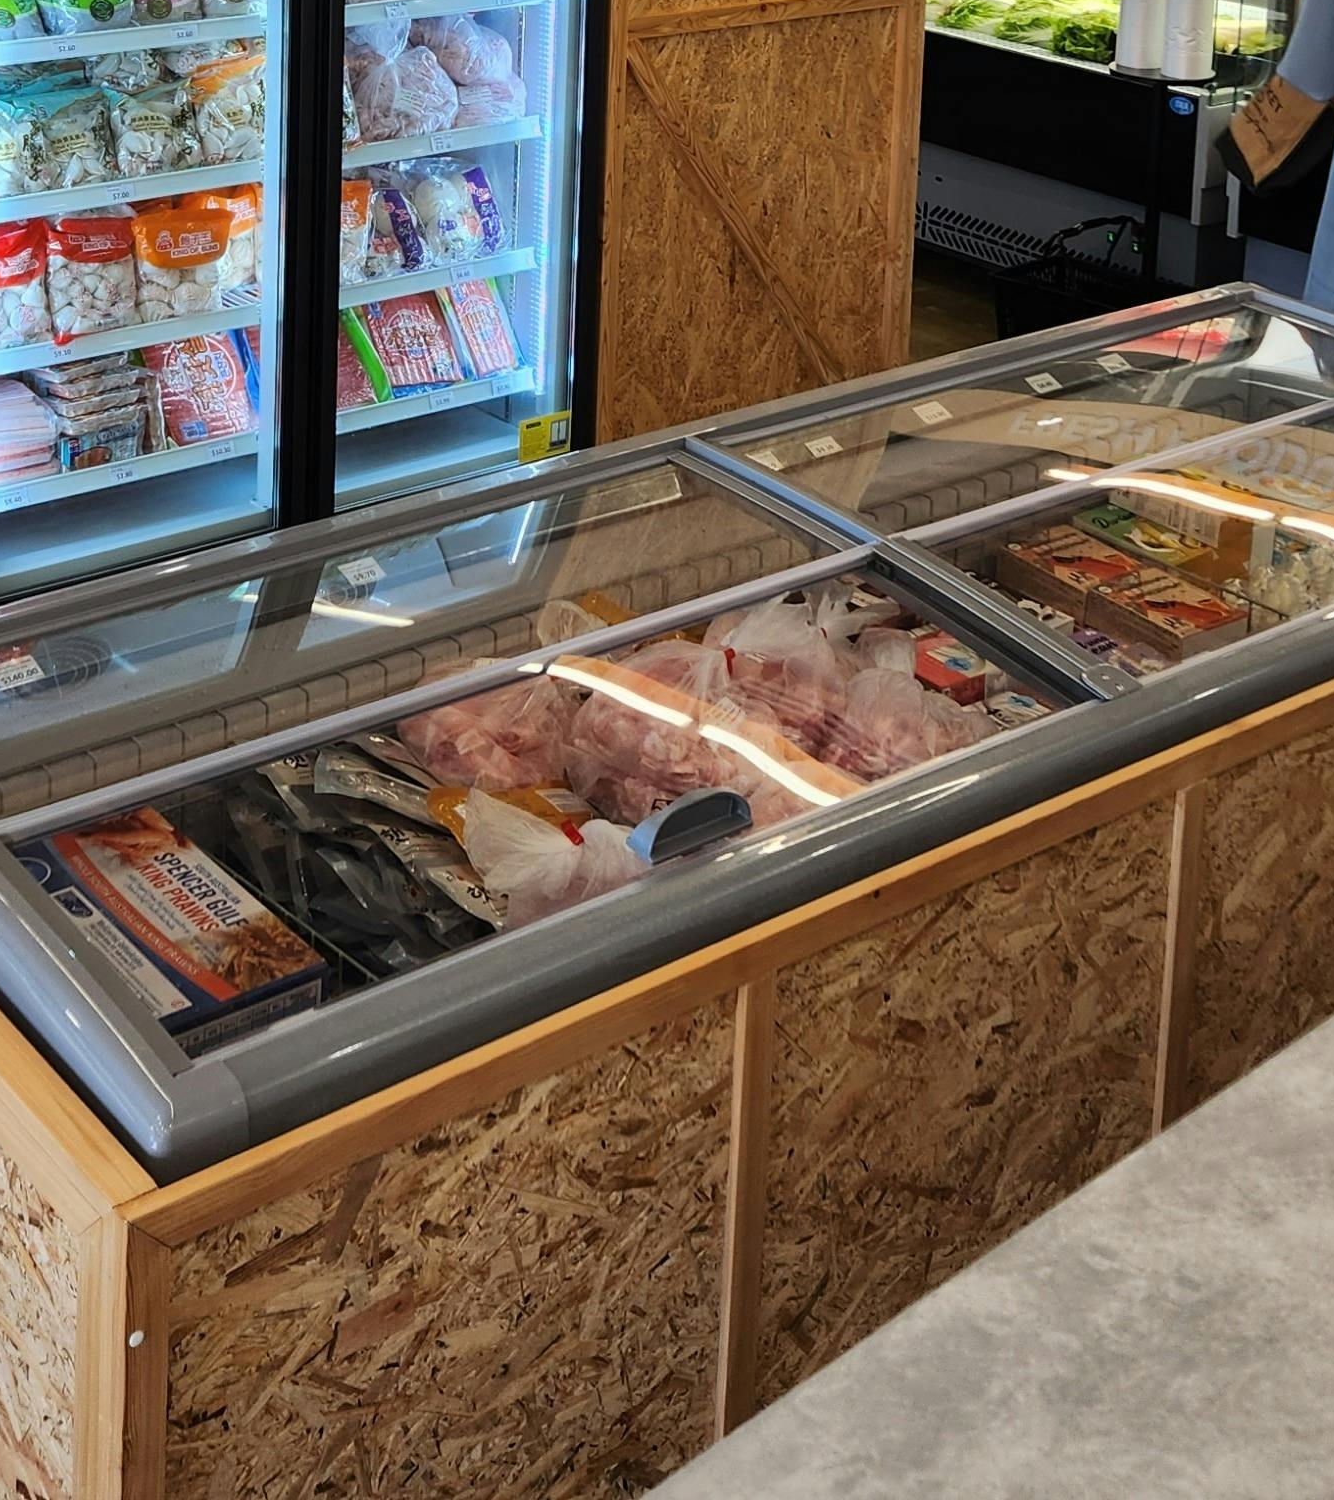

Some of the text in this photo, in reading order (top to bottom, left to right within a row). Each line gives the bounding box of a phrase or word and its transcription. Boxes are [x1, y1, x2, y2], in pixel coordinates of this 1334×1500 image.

[137, 862, 172, 891] KING
[162, 884, 221, 934] PRAWNS
[154, 851, 216, 901] SPENCER
[206, 892, 250, 928] GULF
